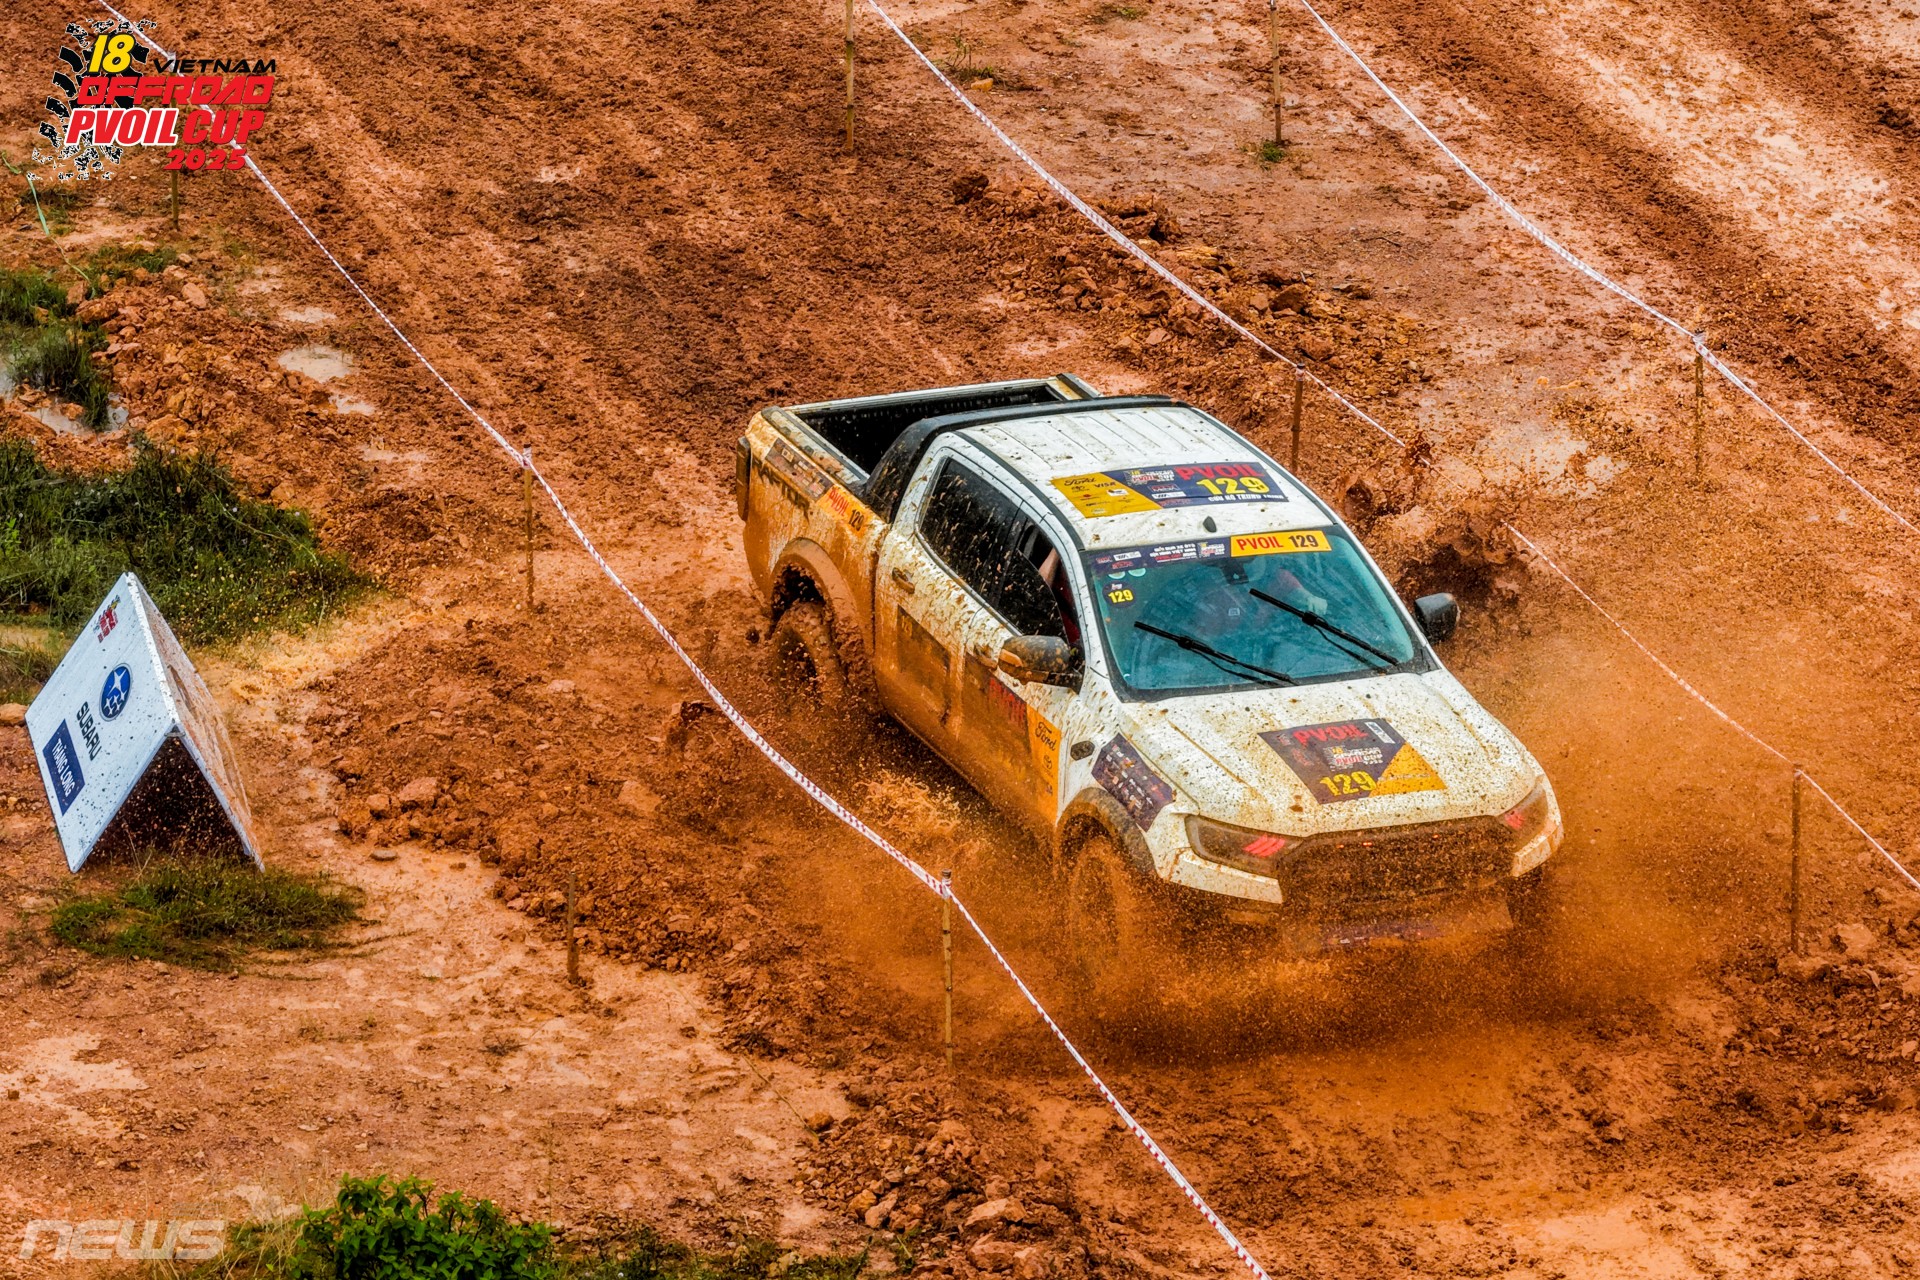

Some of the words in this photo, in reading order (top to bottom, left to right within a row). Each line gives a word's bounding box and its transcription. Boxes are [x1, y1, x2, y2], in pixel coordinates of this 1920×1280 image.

[1173, 463, 1266, 480] PVOIL
[1196, 477, 1270, 497] 129
[848, 508, 865, 532] 129
[1237, 535, 1284, 552] PVOIL
[1288, 534, 1320, 549] 129
[1108, 589, 1134, 604] 129
[76, 701, 102, 761] SUBARU
[1035, 720, 1057, 752] Ford
[1293, 724, 1369, 748] PVOIL
[59, 766, 76, 798] LONG
[1319, 770, 1378, 797] 129
